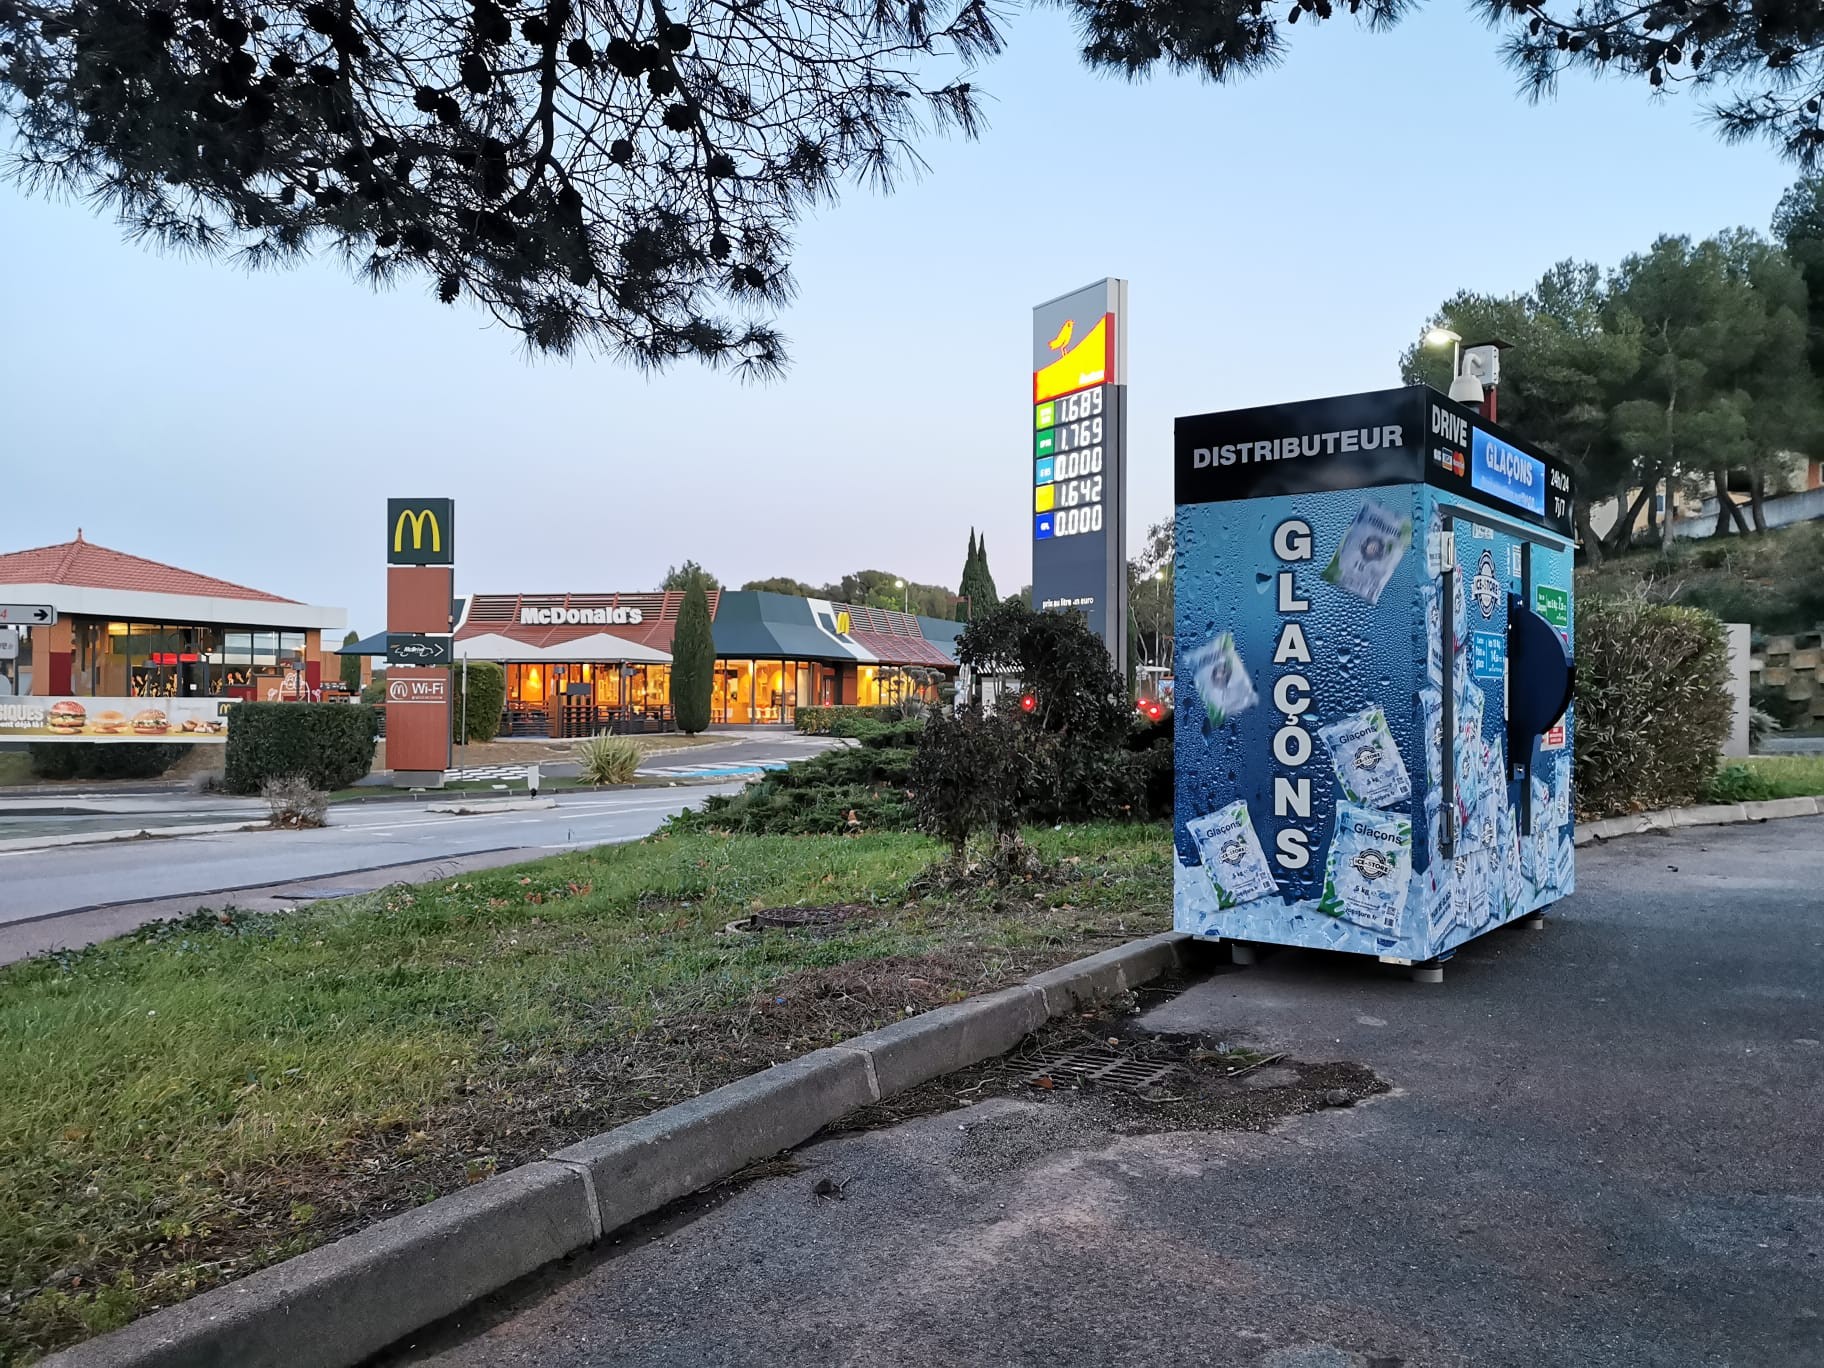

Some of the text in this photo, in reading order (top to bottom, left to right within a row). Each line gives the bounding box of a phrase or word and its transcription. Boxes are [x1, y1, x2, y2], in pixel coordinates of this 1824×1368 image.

[1061, 386, 1103, 423] 1.689
[1061, 417, 1103, 450] 1.769
[1432, 404, 1468, 448] DRIVE
[1193, 424, 1403, 469] DISTRIBUTEUR
[1055, 446, 1103, 482] 0.000
[1485, 441, 1533, 487] GLAÇONS
[1550, 467, 1570, 493] 24h/24
[1061, 475, 1103, 507] 1.642
[1055, 504, 1103, 537] 0.000
[519, 606, 644, 625] McDonald's
[411, 682, 444, 695] Wi-Fi
[1273, 520, 1312, 869] GLAÇONS
[1339, 725, 1378, 744] Glaçons
[1206, 820, 1241, 839] Glaçons
[1354, 822, 1403, 845] Glaçons
